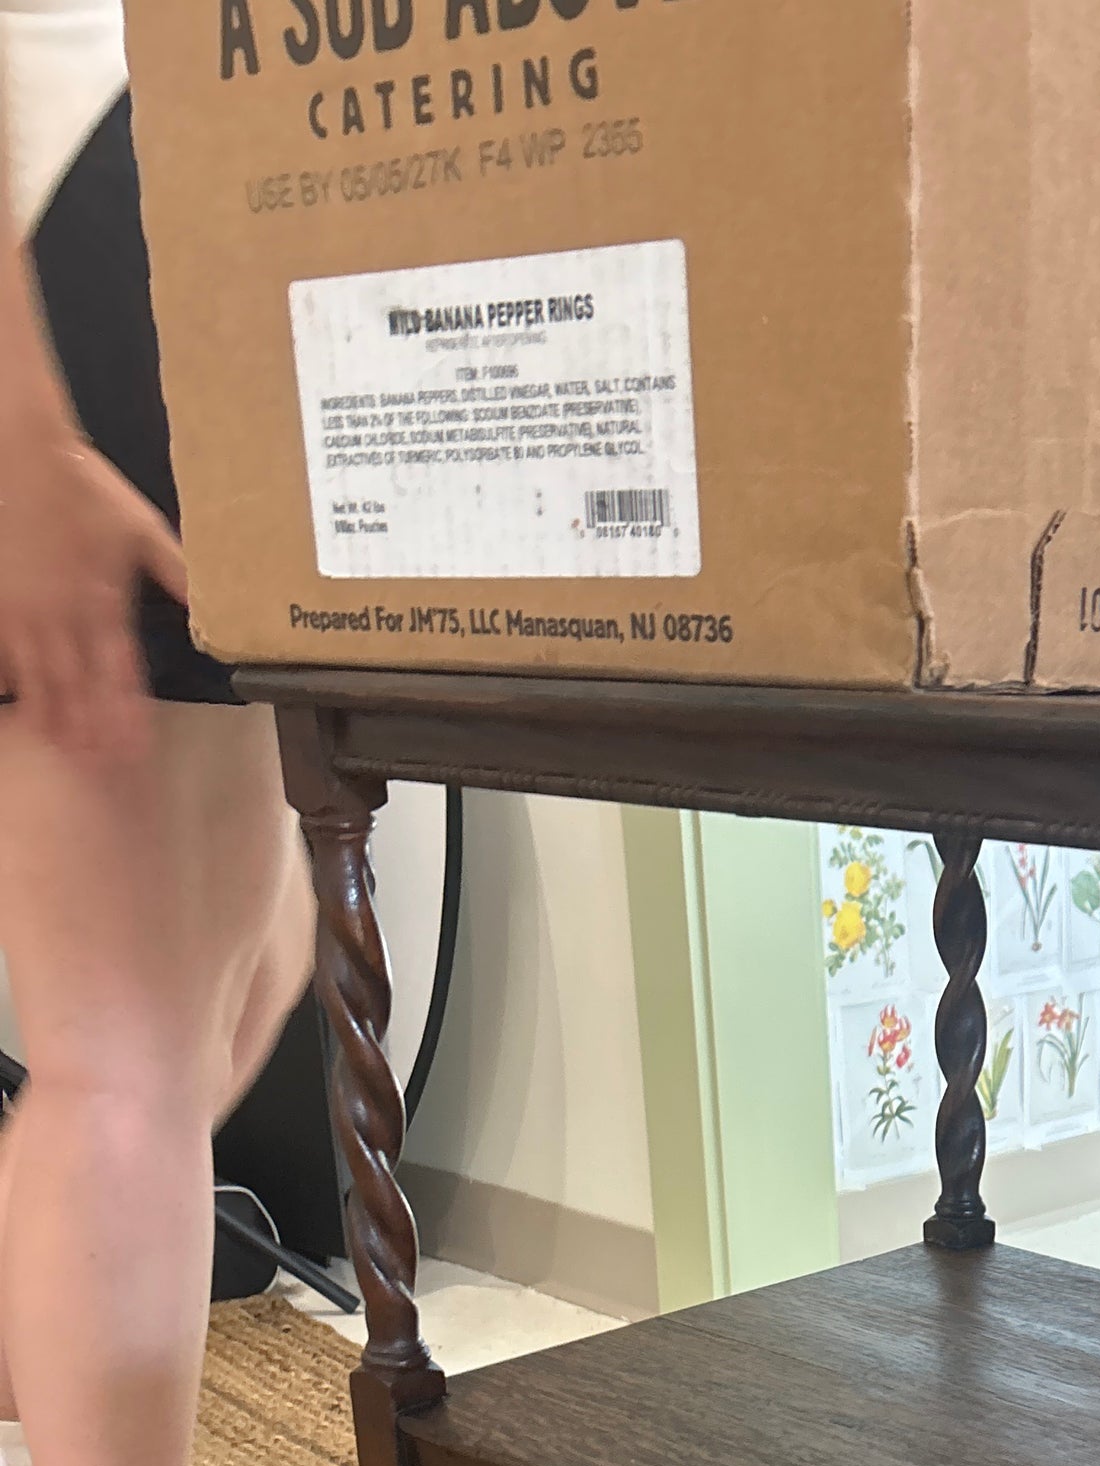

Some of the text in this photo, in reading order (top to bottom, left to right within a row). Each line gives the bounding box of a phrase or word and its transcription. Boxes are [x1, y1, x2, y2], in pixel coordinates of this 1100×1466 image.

[220, 0, 260, 80] A
[308, 47, 601, 139] CATERING
[245, 172, 295, 213] USE
[299, 168, 334, 206] BY
[478, 137, 513, 177] F4
[519, 127, 567, 169] WP
[424, 304, 485, 333] BANANA
[487, 299, 545, 329] PEPPER
[547, 293, 595, 323] RINGS
[596, 419, 642, 436] NATURAL
[290, 603, 371, 633] Prepared
[375, 605, 404, 632] For
[469, 608, 500, 634] LLC
[506, 609, 624, 643] Manasquan,
[630, 612, 656, 640] NJ
[663, 613, 733, 643] 08736
